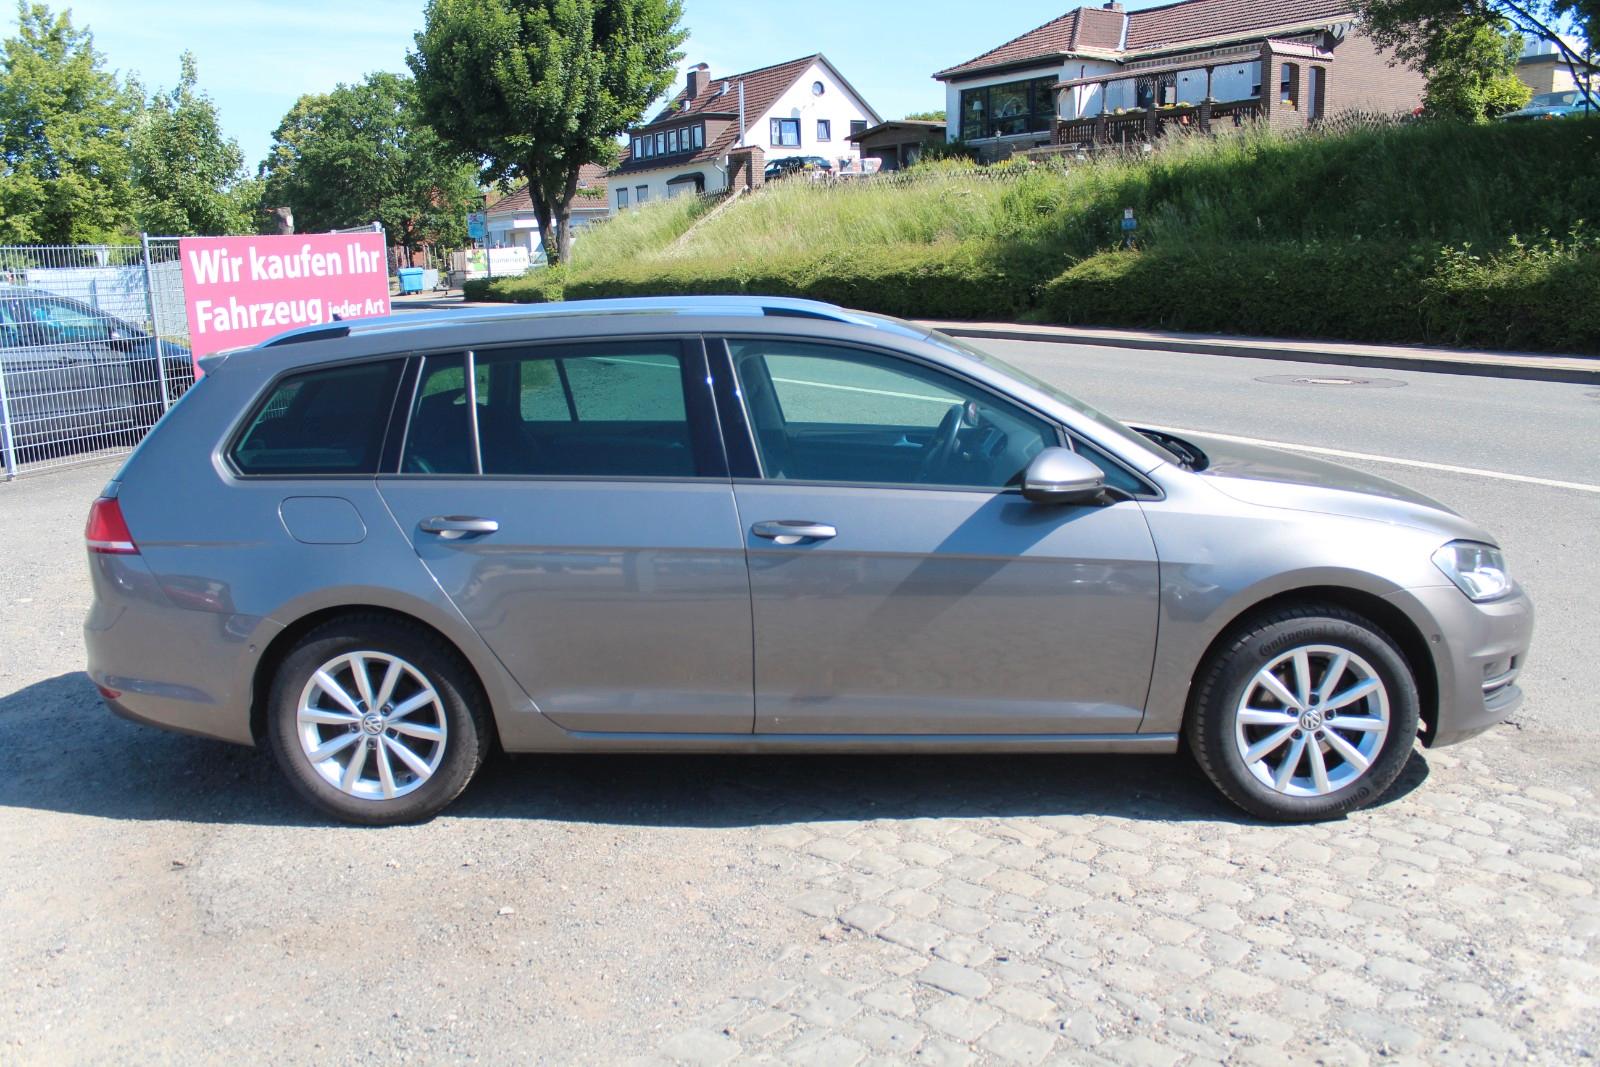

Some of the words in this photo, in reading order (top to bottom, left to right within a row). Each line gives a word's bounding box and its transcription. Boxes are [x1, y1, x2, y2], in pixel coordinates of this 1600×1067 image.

[188, 248, 243, 284] Wir
[248, 244, 343, 280] kaufen
[346, 243, 381, 275] Ihr
[195, 296, 323, 333] Fahrzeug
[327, 299, 362, 323] jeder
[364, 298, 385, 315] Art
